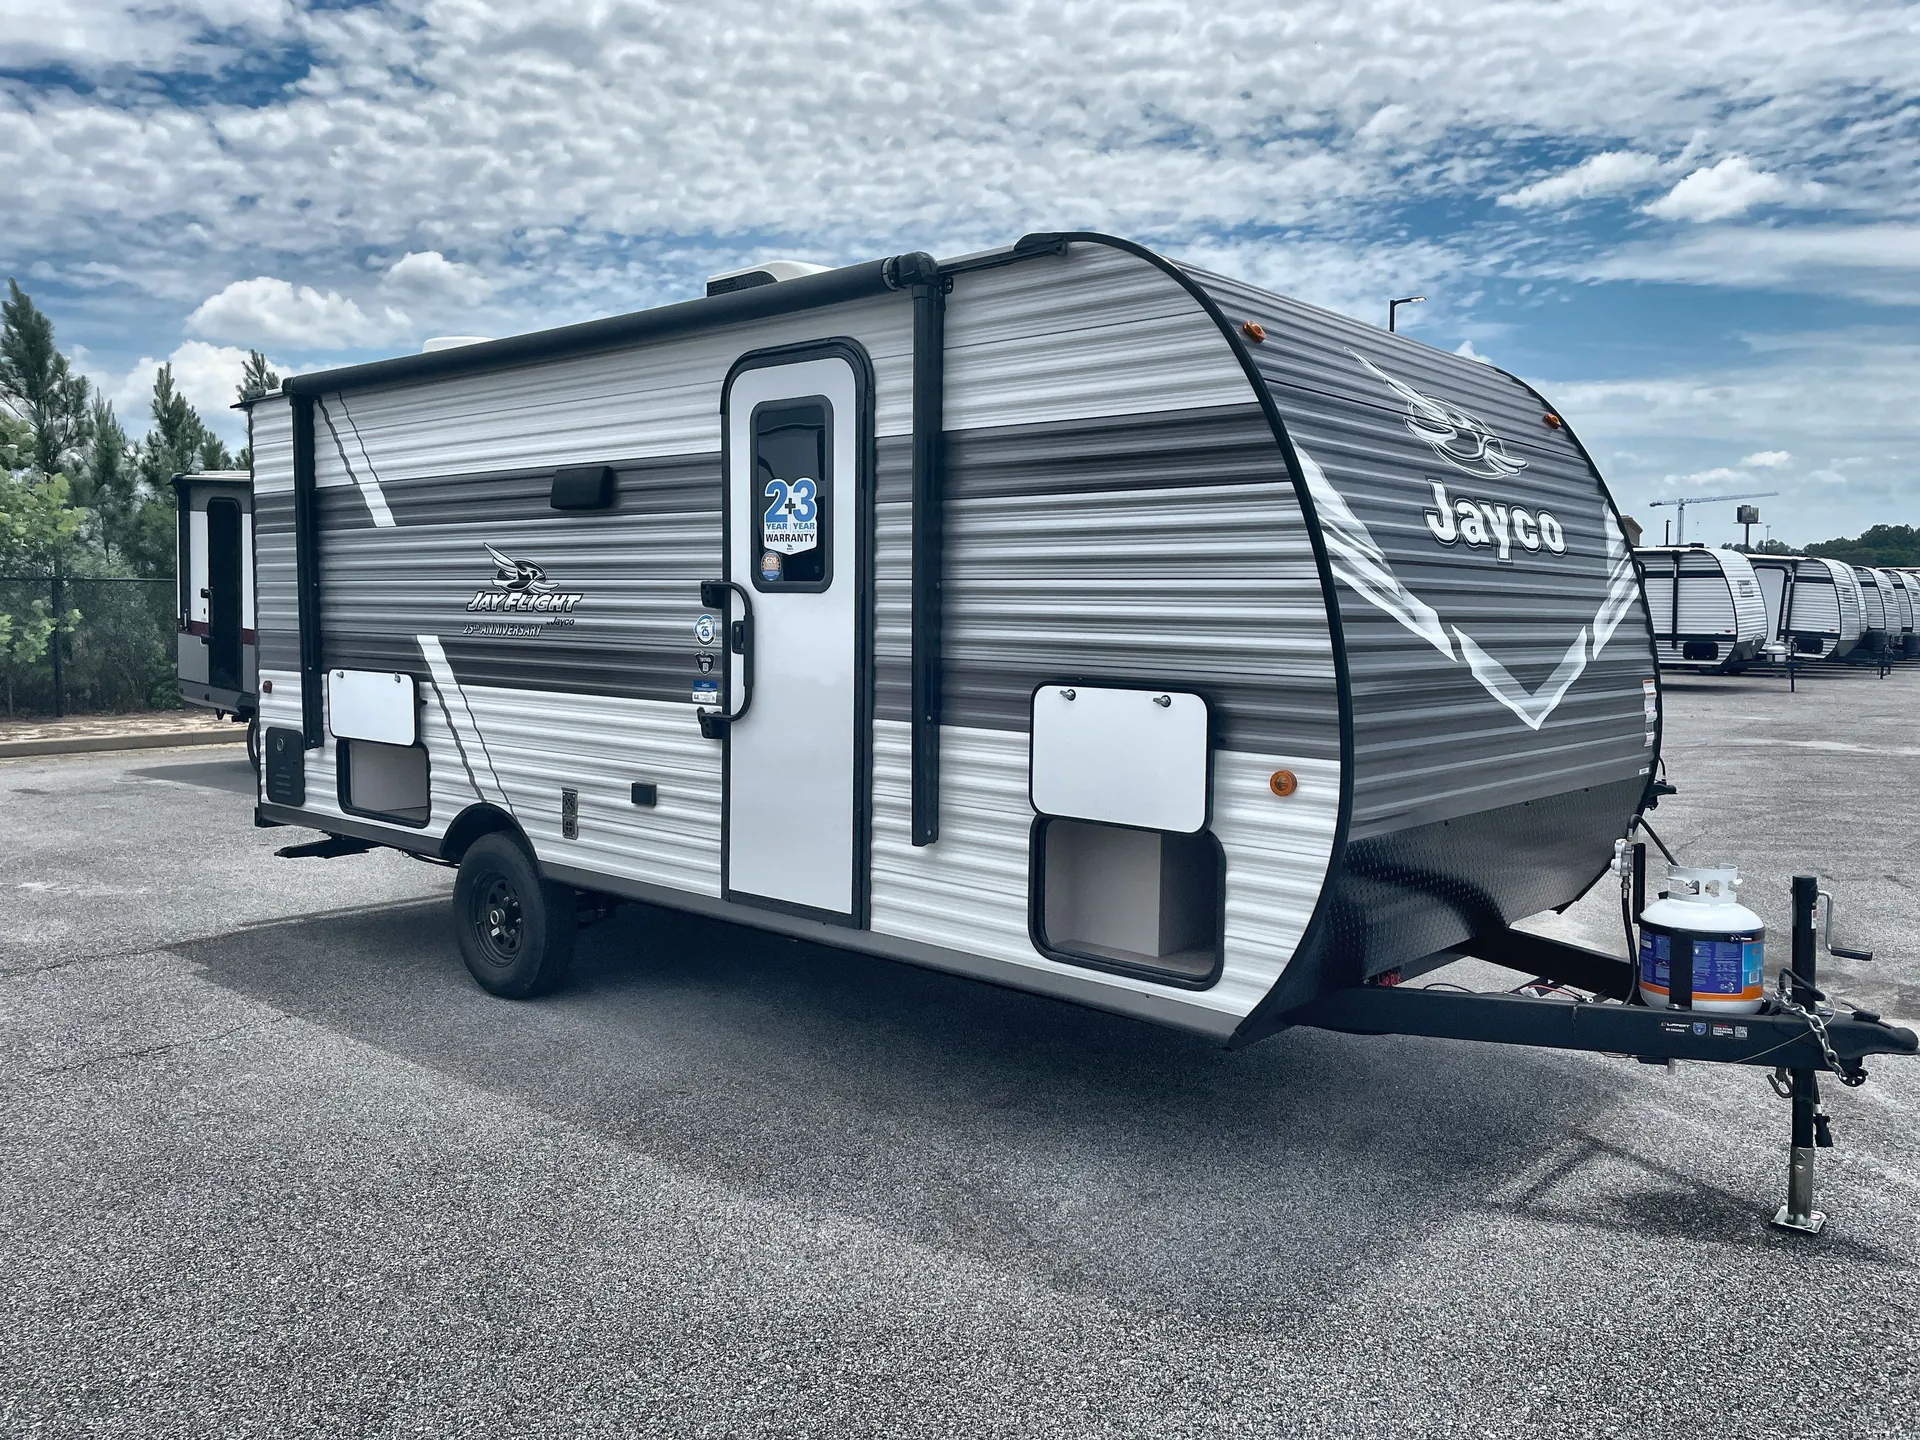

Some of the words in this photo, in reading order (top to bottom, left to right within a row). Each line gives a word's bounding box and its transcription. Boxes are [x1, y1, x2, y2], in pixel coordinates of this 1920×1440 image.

[1424, 478, 1567, 562] Jayco
[793, 522, 816, 530] YEAR
[765, 533, 815, 543] WARRANTY
[550, 617, 575, 627] Jayco
[479, 624, 543, 637] ANNIVERSARY
